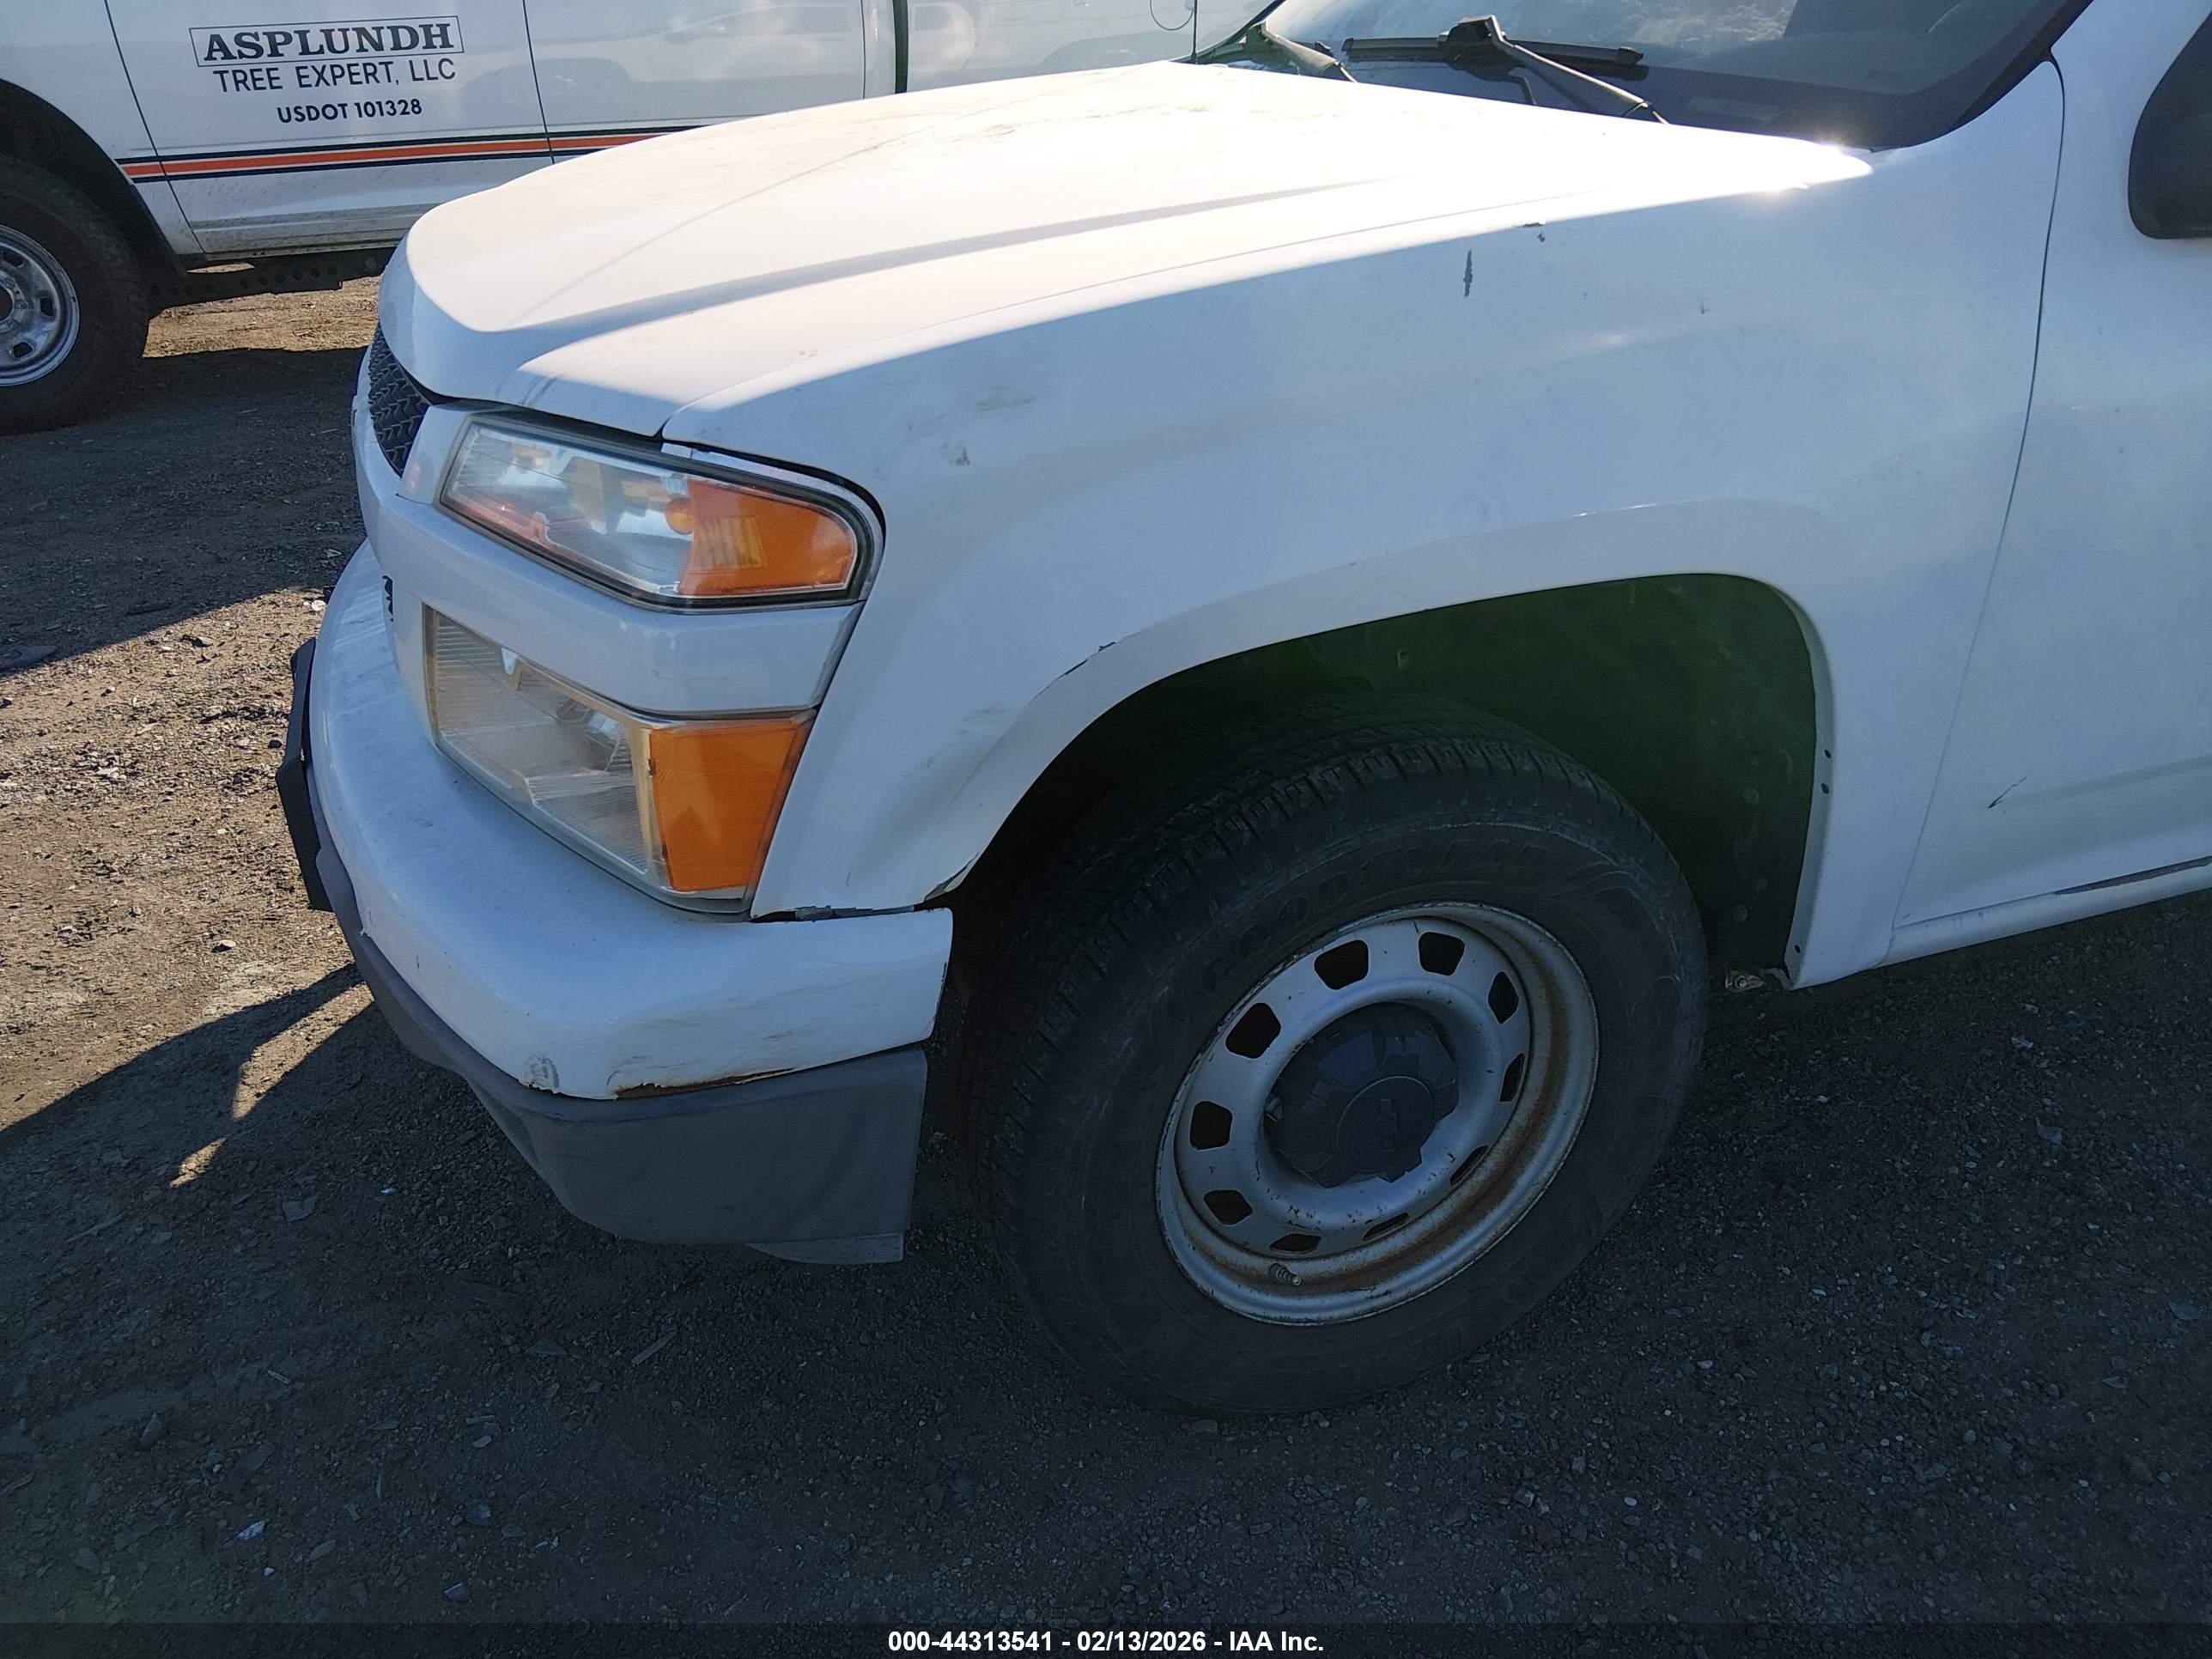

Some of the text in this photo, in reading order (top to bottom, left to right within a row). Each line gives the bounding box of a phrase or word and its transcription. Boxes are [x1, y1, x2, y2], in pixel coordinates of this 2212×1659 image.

[204, 23, 454, 61] ASPLUNDH
[213, 58, 456, 93] TREE EXPERT, LLC
[276, 99, 422, 124] USDOT 101328
